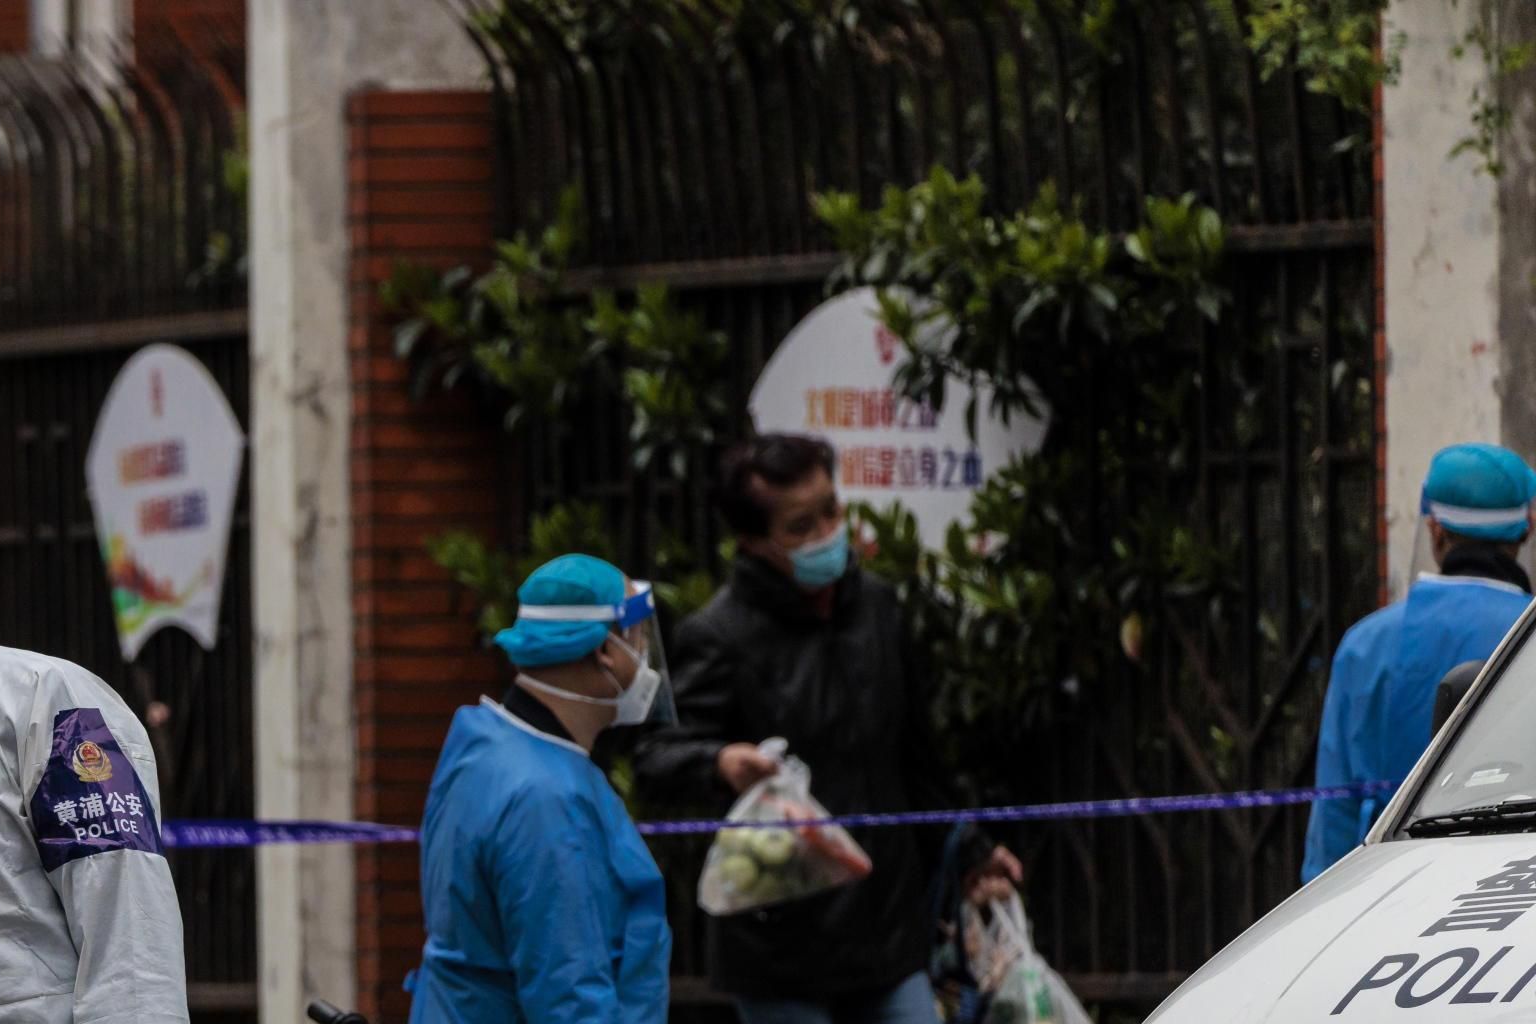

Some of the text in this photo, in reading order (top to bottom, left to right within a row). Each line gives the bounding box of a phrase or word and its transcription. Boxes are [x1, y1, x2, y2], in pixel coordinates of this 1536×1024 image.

[53, 791, 144, 826] 黄浦公安
[75, 820, 139, 841] POLICE
